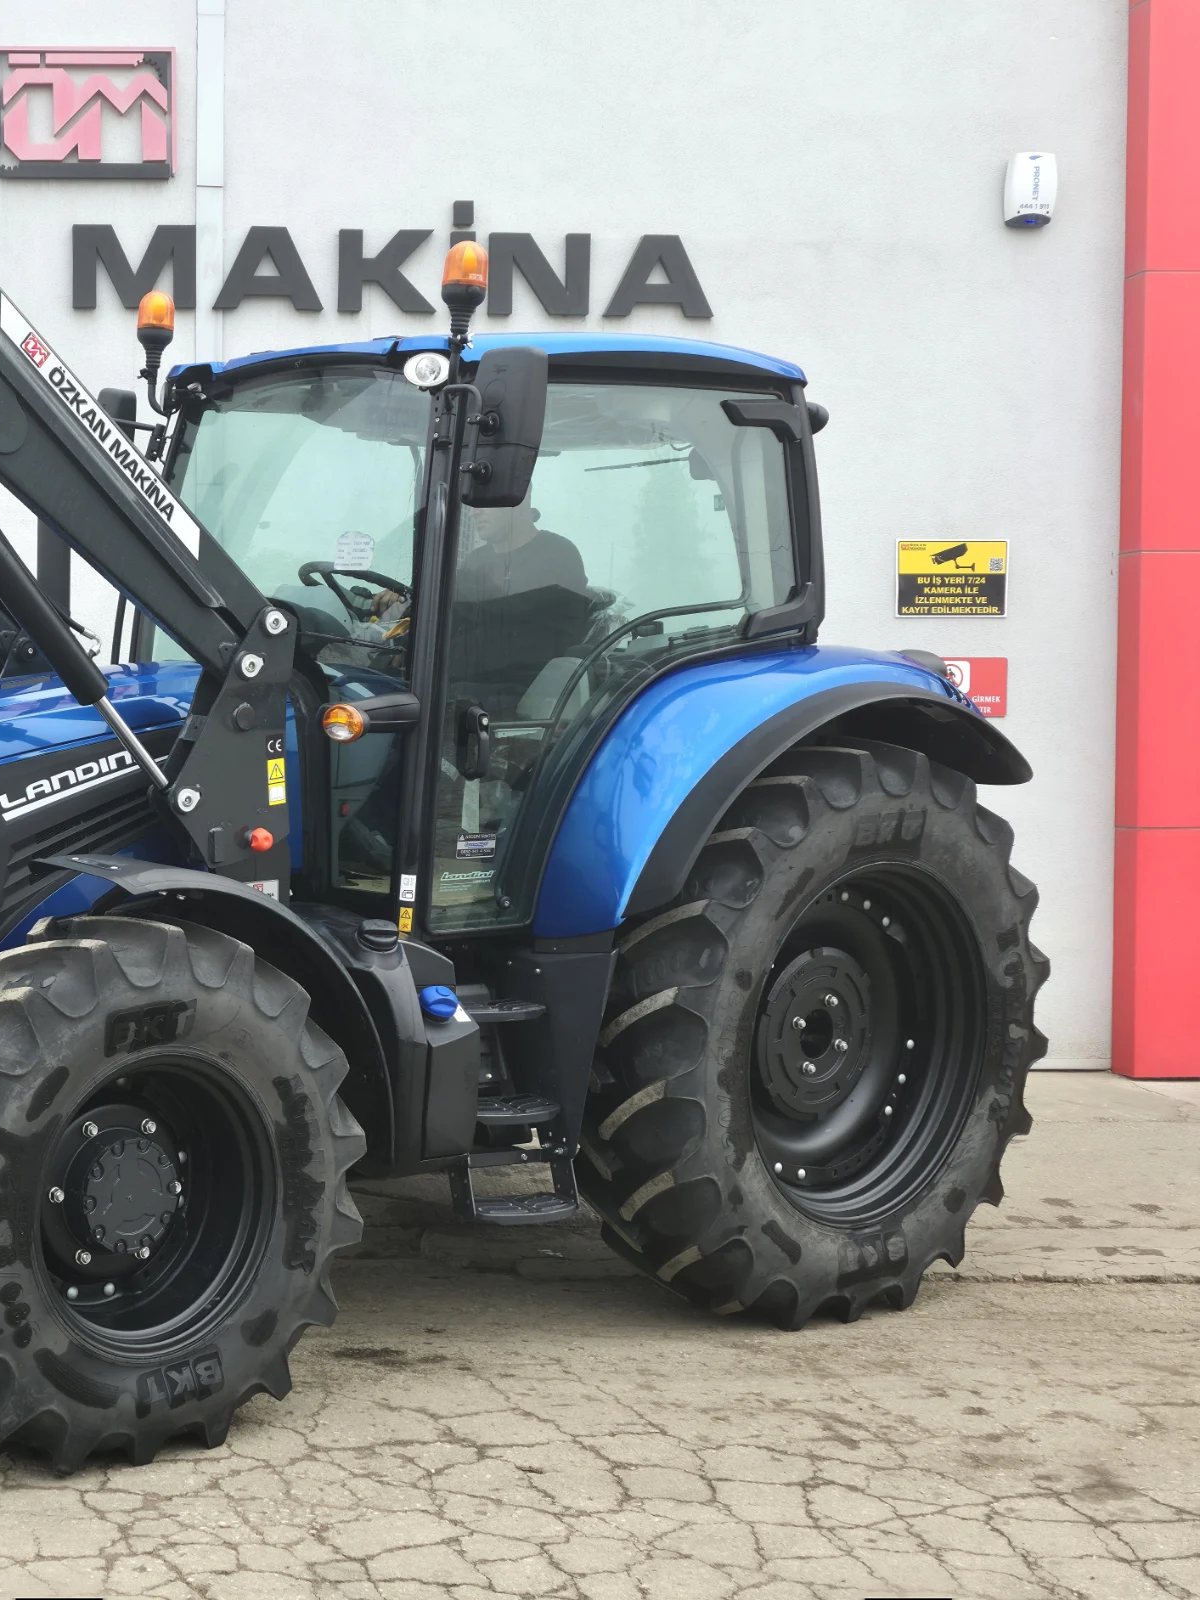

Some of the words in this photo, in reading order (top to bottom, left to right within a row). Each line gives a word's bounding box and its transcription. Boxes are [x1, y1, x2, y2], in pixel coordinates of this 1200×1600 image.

[1032, 166, 1040, 201] PRONET
[48, 366, 112, 444] ÖZKAN
[108, 438, 175, 523] MAKİNA
[933, 575, 941, 585] İŞ
[944, 576, 965, 584] YERİ
[965, 585, 979, 594] İLE
[915, 595, 973, 604] İZLENMEKTE
[902, 606, 929, 614] KAYIT
[932, 605, 1001, 614] EDİLMEKTEDİR.
[972, 695, 1001, 703] GİRMEK
[0, 750, 138, 808] LANDIN
[143, 1358, 224, 1404] BKT
